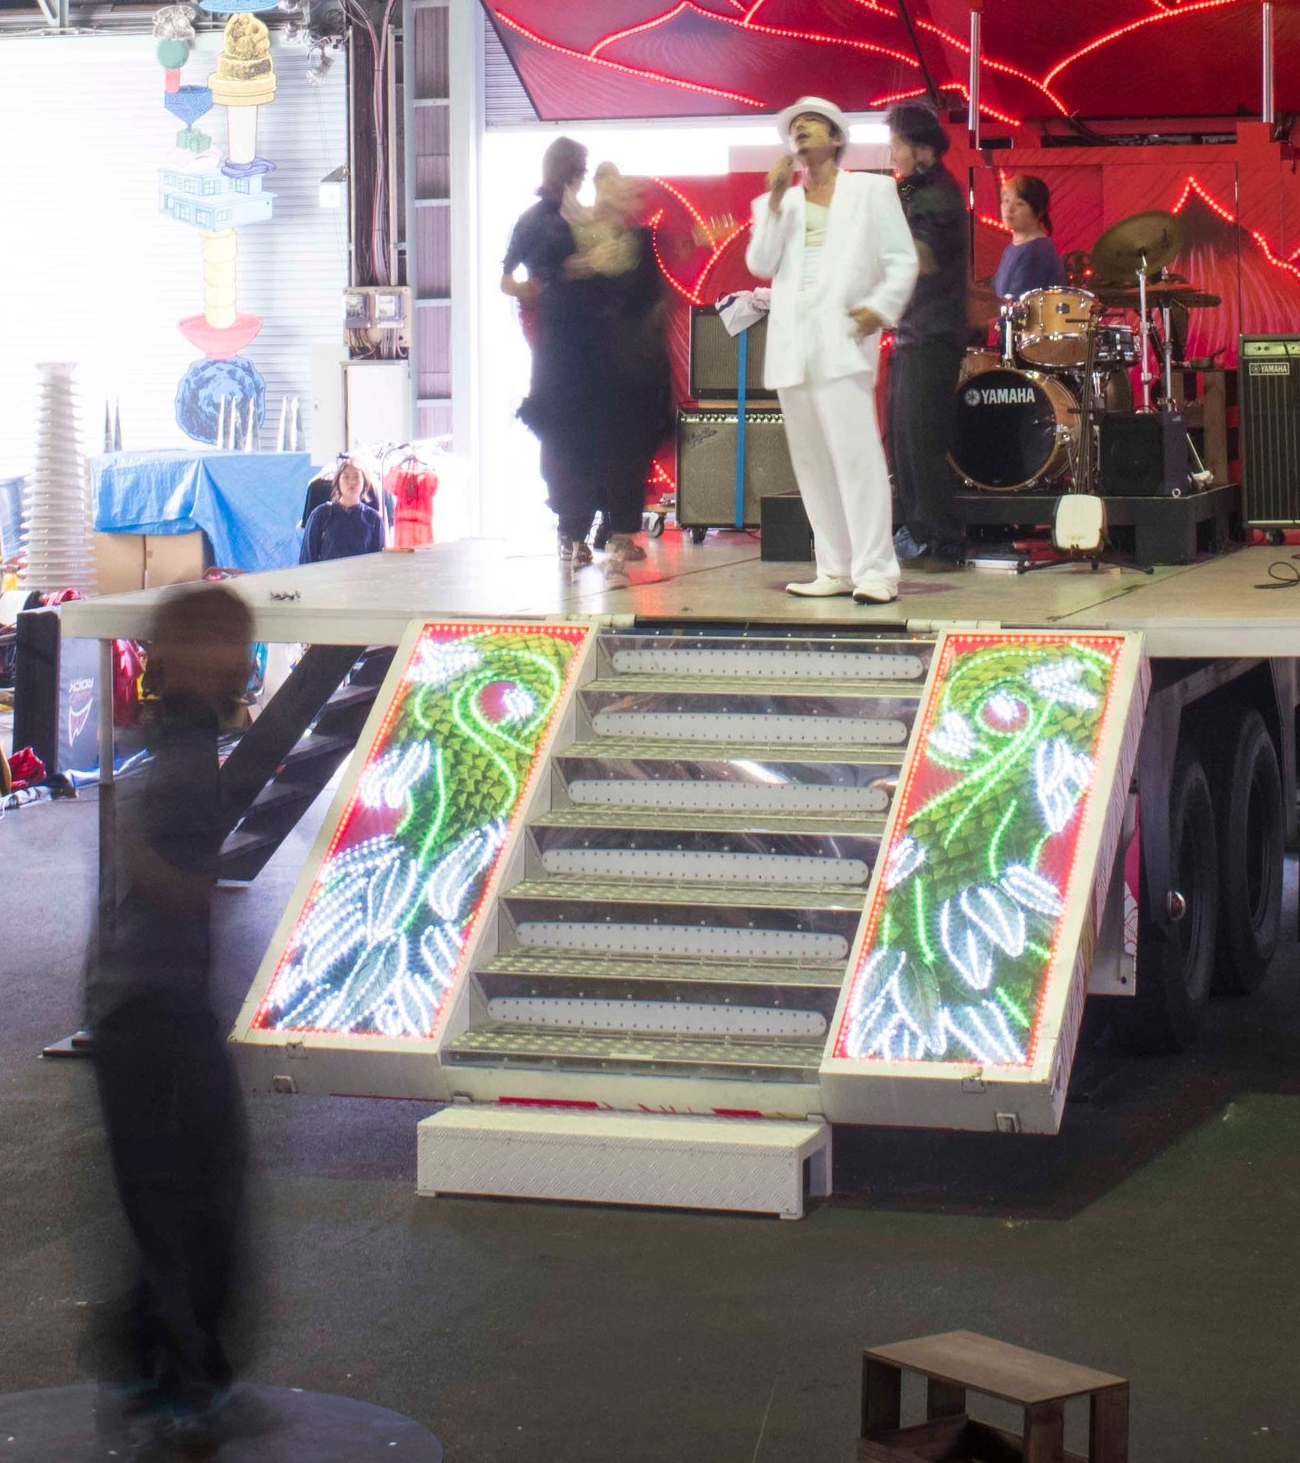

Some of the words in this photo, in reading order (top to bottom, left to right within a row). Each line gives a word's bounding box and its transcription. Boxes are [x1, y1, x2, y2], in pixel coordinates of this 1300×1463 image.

[1261, 364, 1287, 373] YAMAHA
[981, 388, 1035, 404] YAMAHA
[69, 678, 94, 693] ROCK
